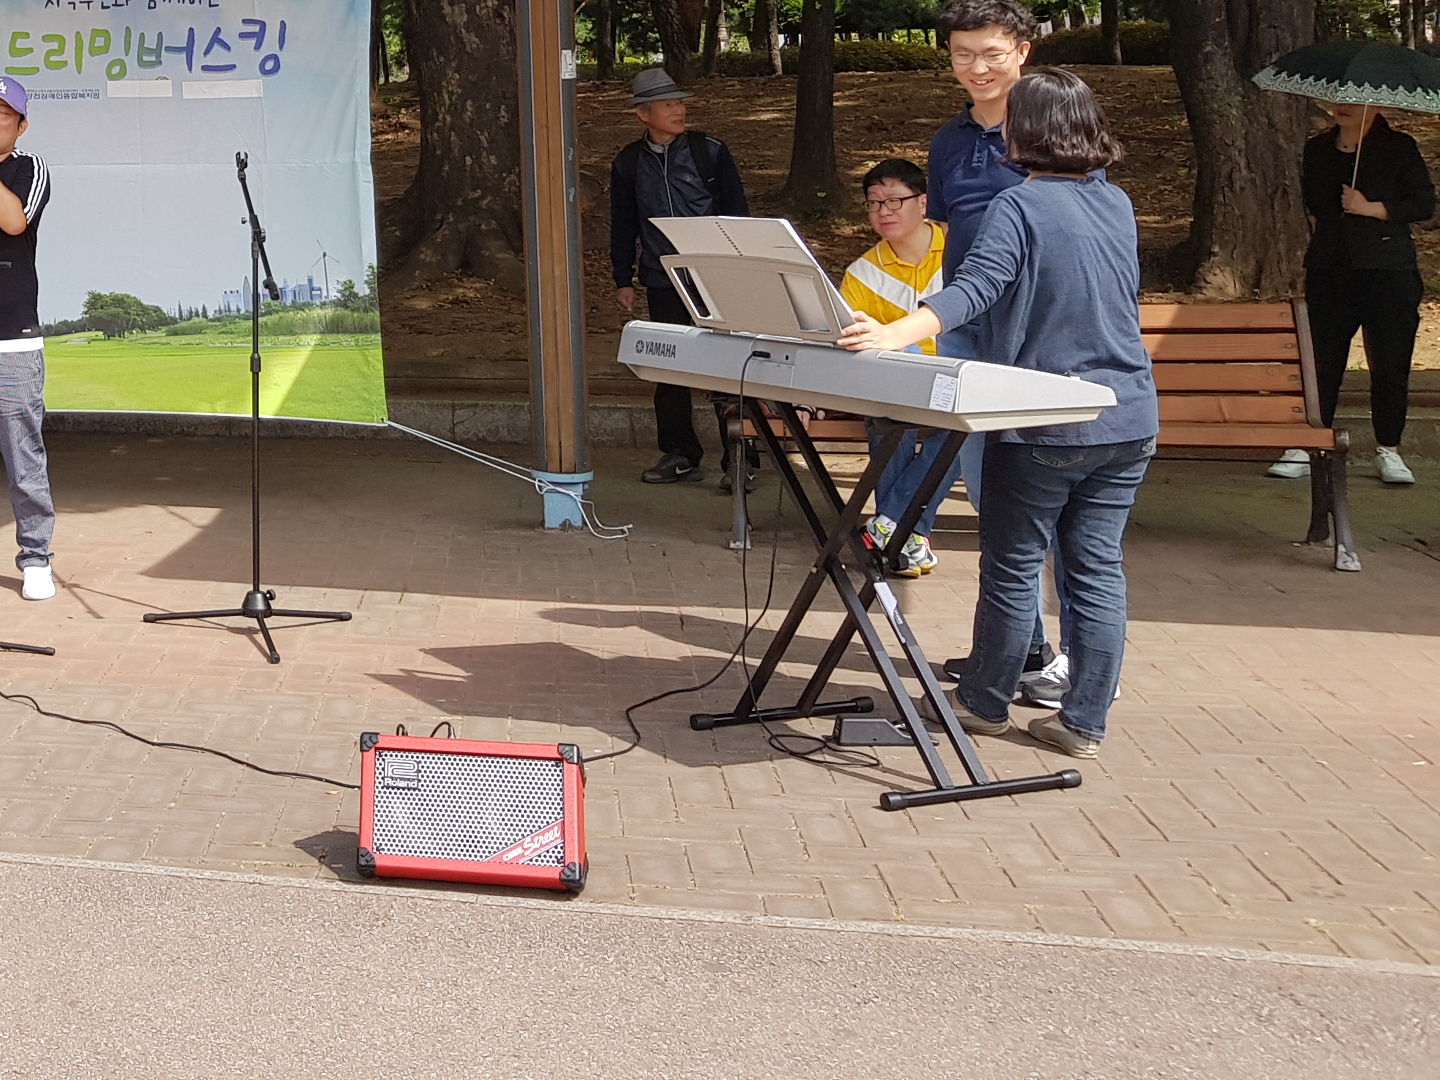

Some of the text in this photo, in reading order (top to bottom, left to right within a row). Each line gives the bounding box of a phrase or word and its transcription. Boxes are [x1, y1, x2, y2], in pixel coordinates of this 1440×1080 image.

[4, 18, 287, 81] 드리밍버스킹
[645, 340, 676, 359] YAMAHA
[384, 778, 418, 788] Roland
[523, 825, 561, 856] Street
